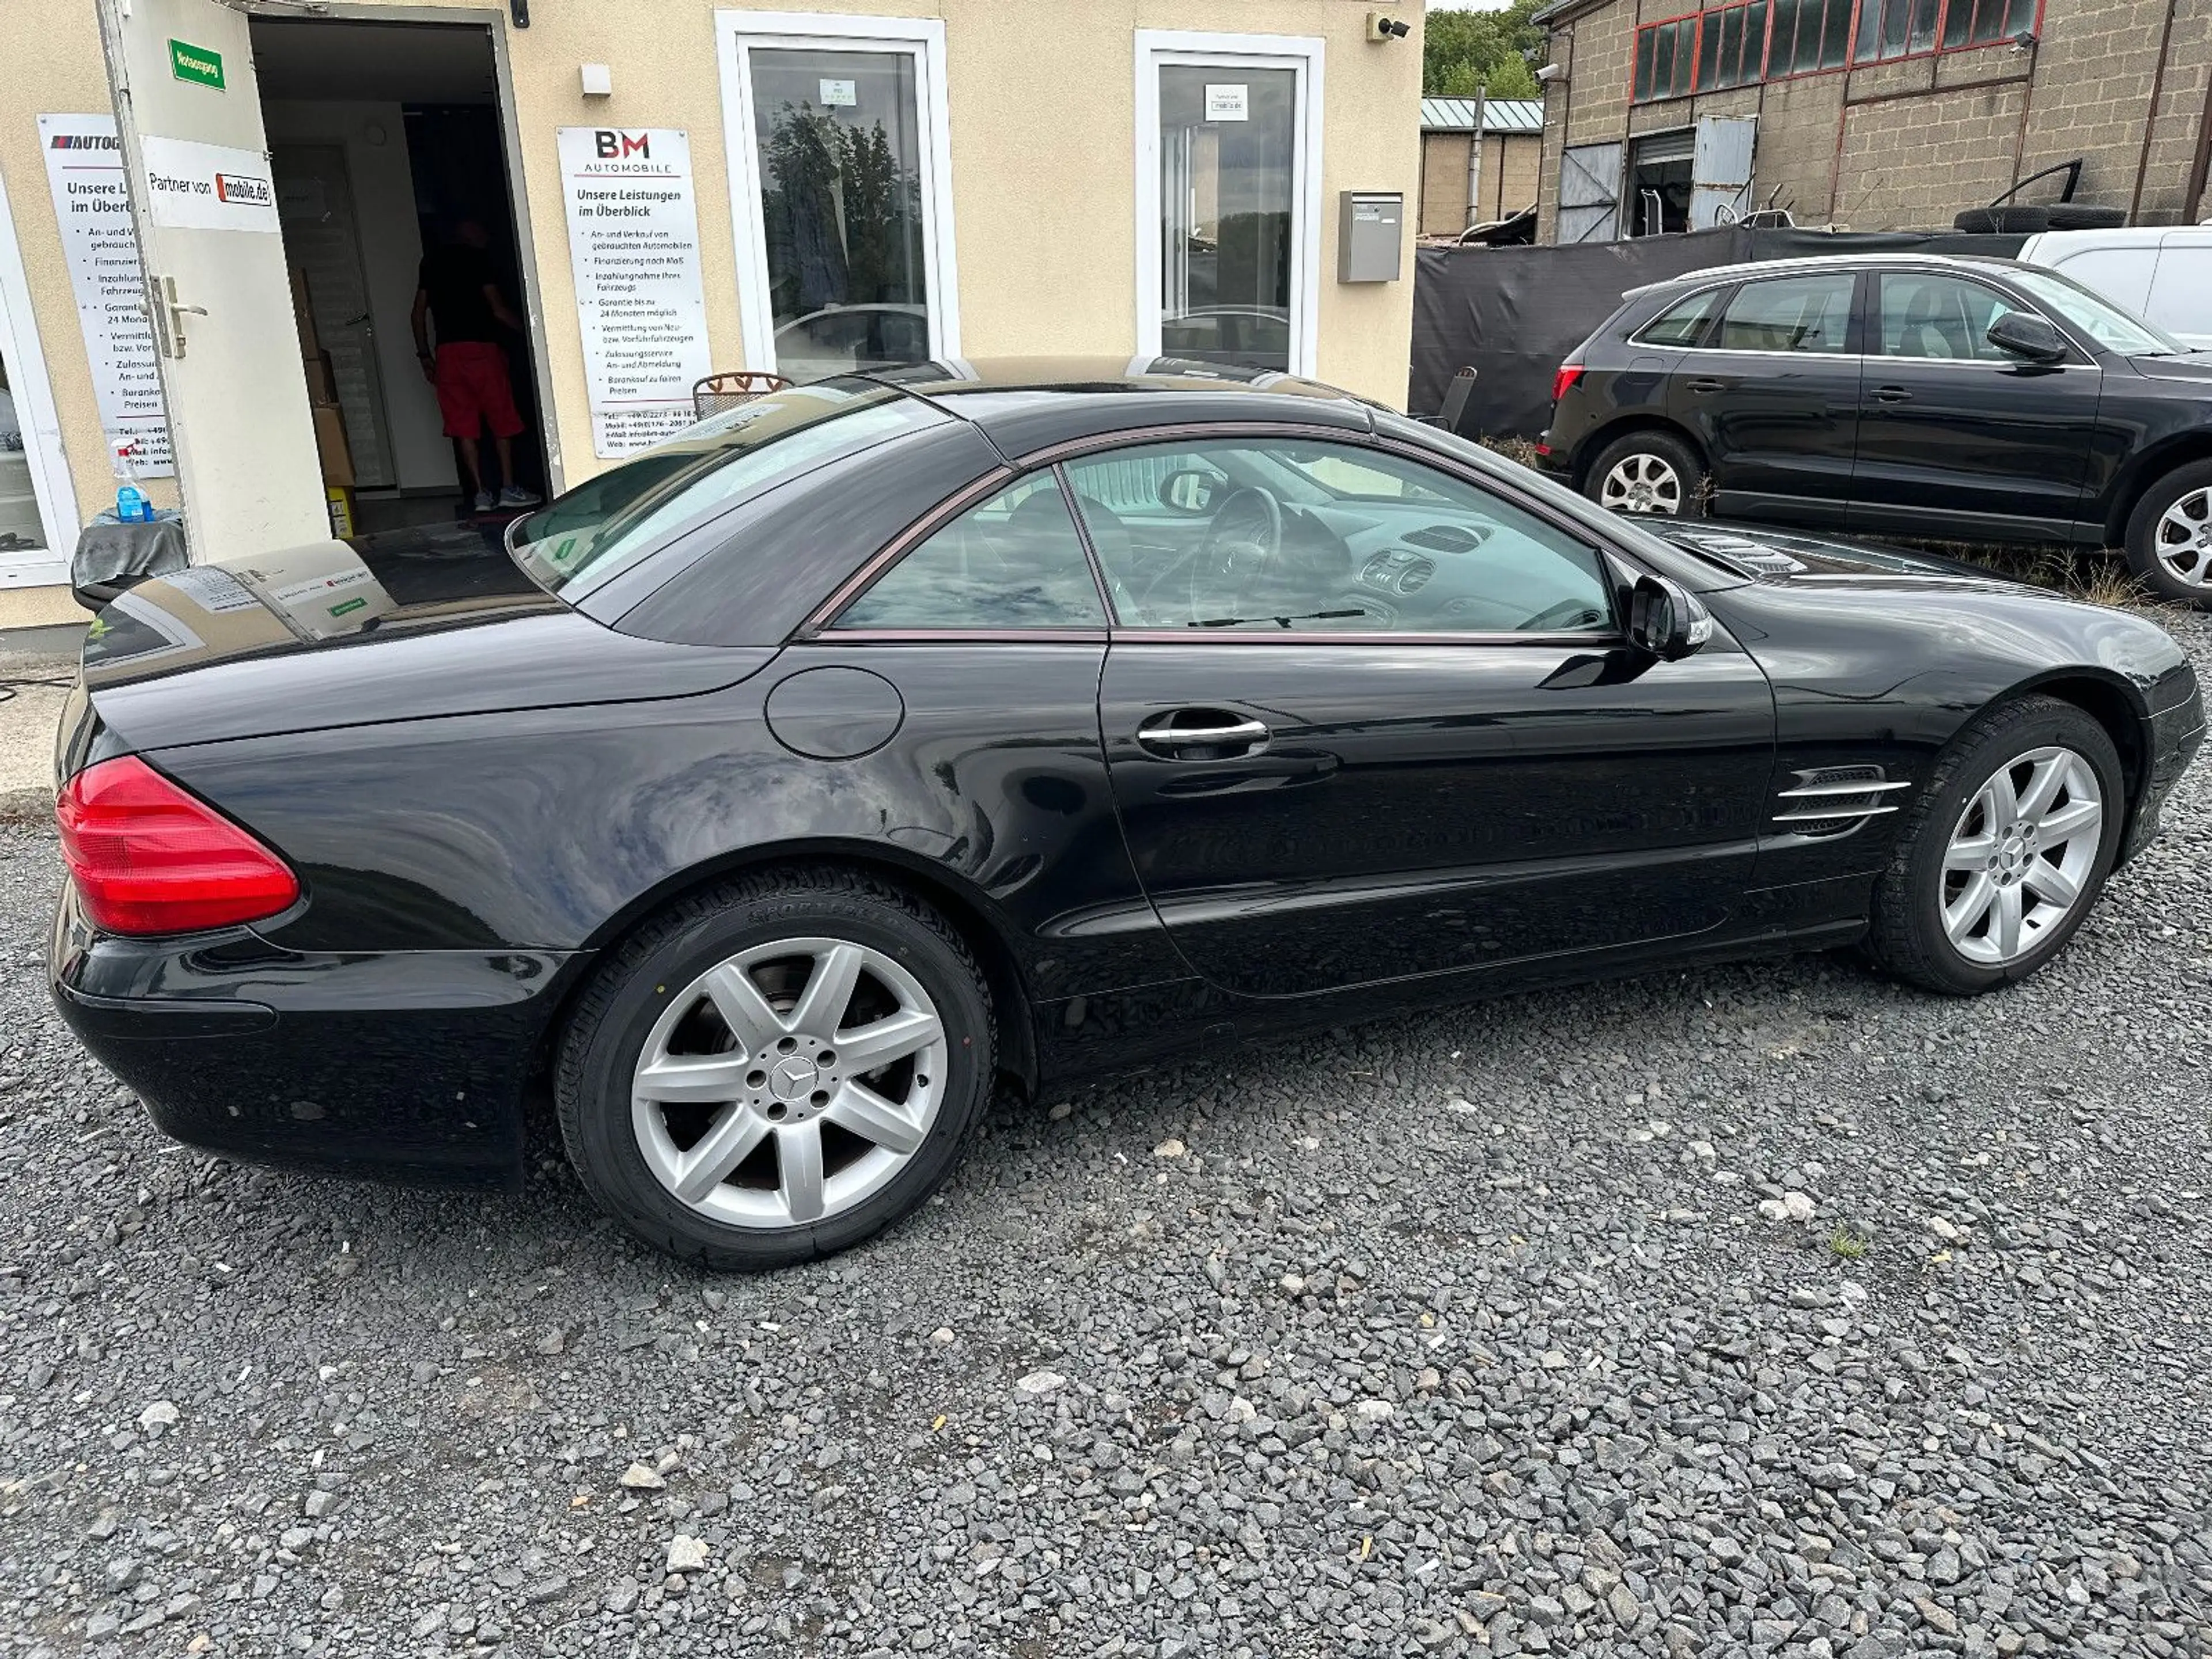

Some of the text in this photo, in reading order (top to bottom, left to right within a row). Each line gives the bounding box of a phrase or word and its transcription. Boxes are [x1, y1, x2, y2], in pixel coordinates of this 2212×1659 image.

[177, 50, 218, 78] Notausgang
[594, 131, 650, 159] BM
[585, 164, 672, 173] AUTOMOBILE
[67, 183, 116, 194] Unsere
[149, 173, 190, 192] Partner
[192, 182, 211, 195] von
[225, 180, 268, 200] mobile.de
[577, 189, 681, 203] Unsere Leistungen
[71, 200, 88, 212] im
[579, 203, 651, 217] im Überblick
[592, 241, 692, 251] gebrauchten Automobilen
[594, 257, 644, 266] Finanzierung
[595, 272, 660, 281] Inzahlungnahme
[597, 284, 637, 293] Fahrzeugs
[600, 309, 609, 317] 24
[647, 309, 677, 318] möglich
[601, 324, 646, 333] Vermittlung
[603, 336, 620, 344] bzw.
[605, 350, 673, 358] Zulassungsservice
[637, 361, 681, 369] Abmeldung
[608, 376, 648, 384] Barankauf
[124, 400, 157, 408] Preisen
